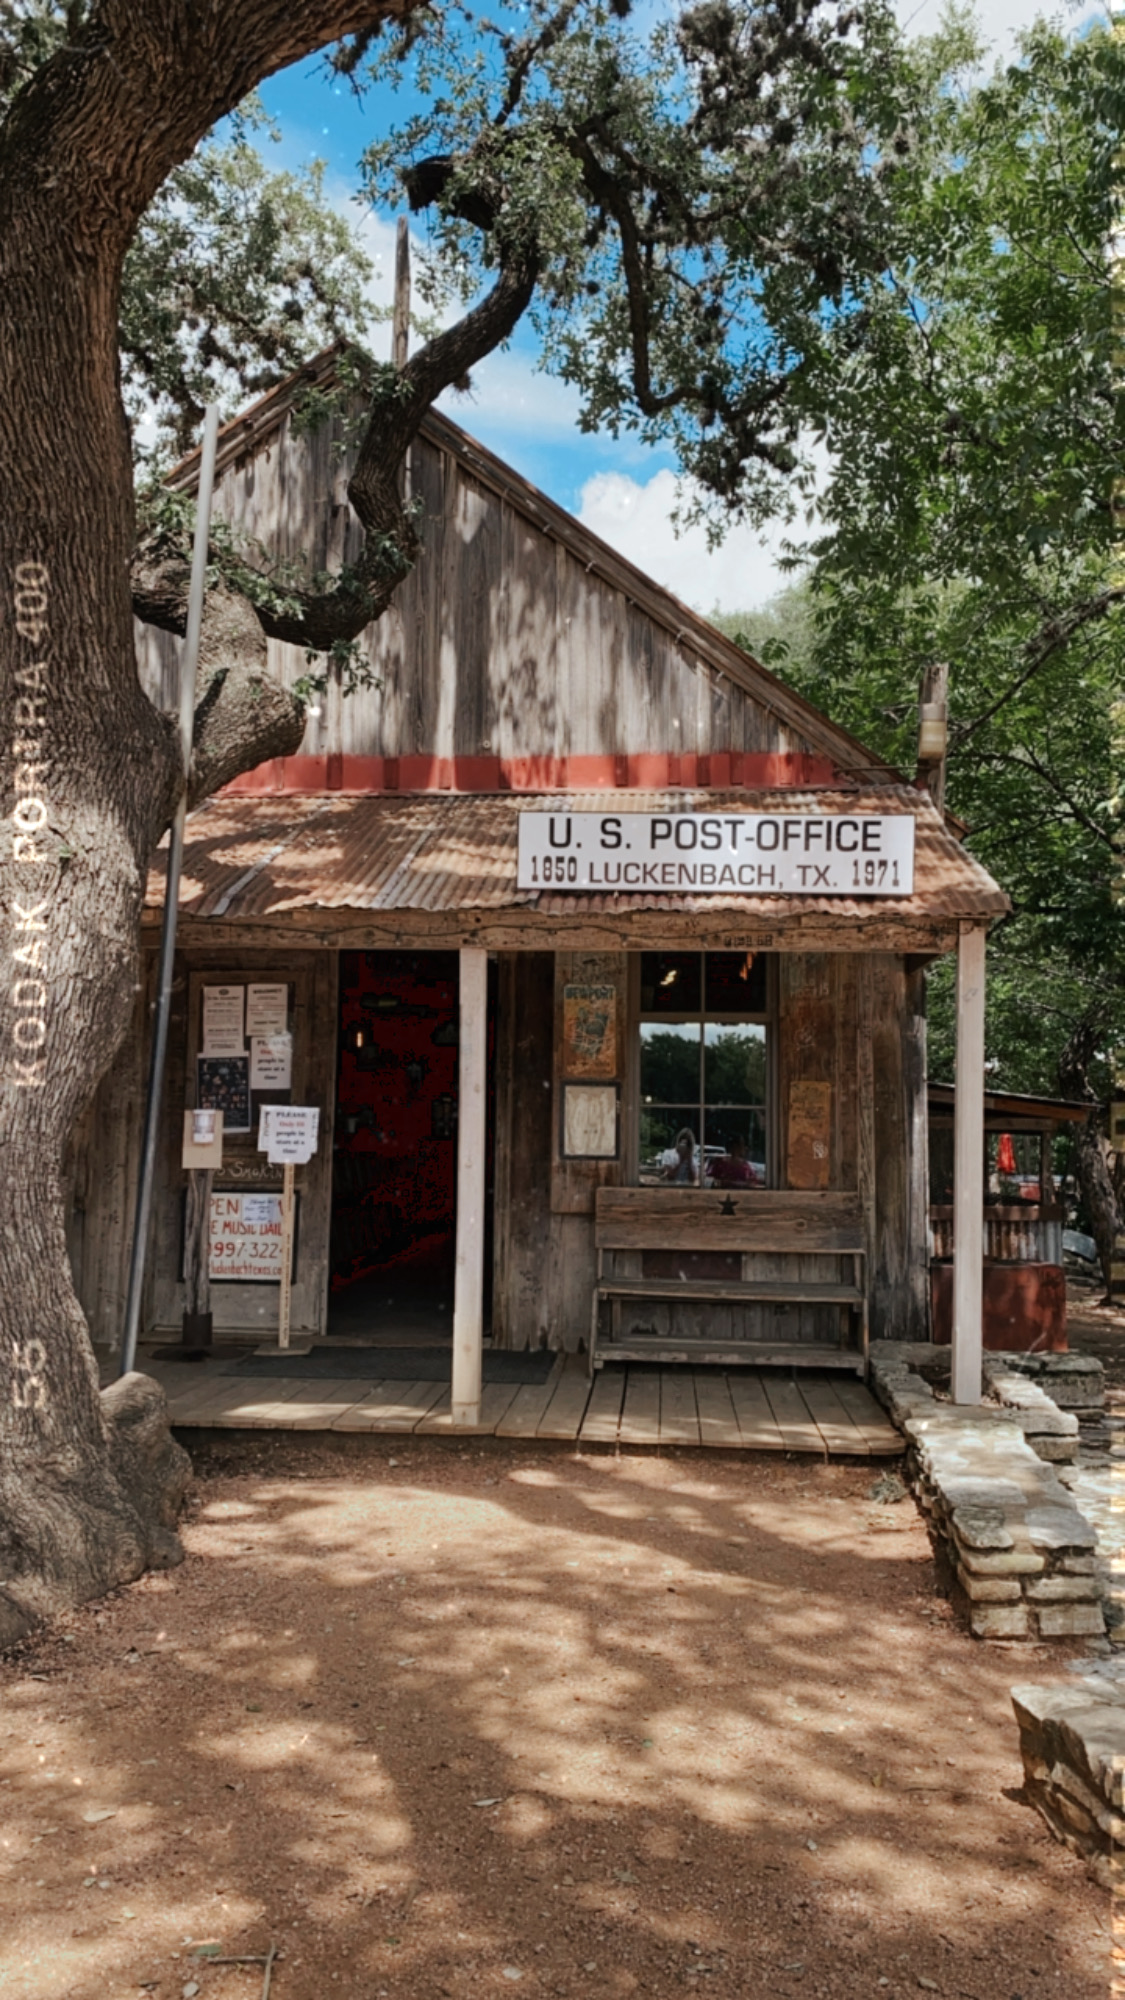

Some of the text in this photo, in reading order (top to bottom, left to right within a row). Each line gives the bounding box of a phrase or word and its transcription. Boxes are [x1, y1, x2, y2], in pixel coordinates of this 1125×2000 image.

[549, 817, 582, 849] U.
[600, 817, 631, 850] S.
[531, 855, 900, 889] 1850 LUCKENBACH, TX. 1971
